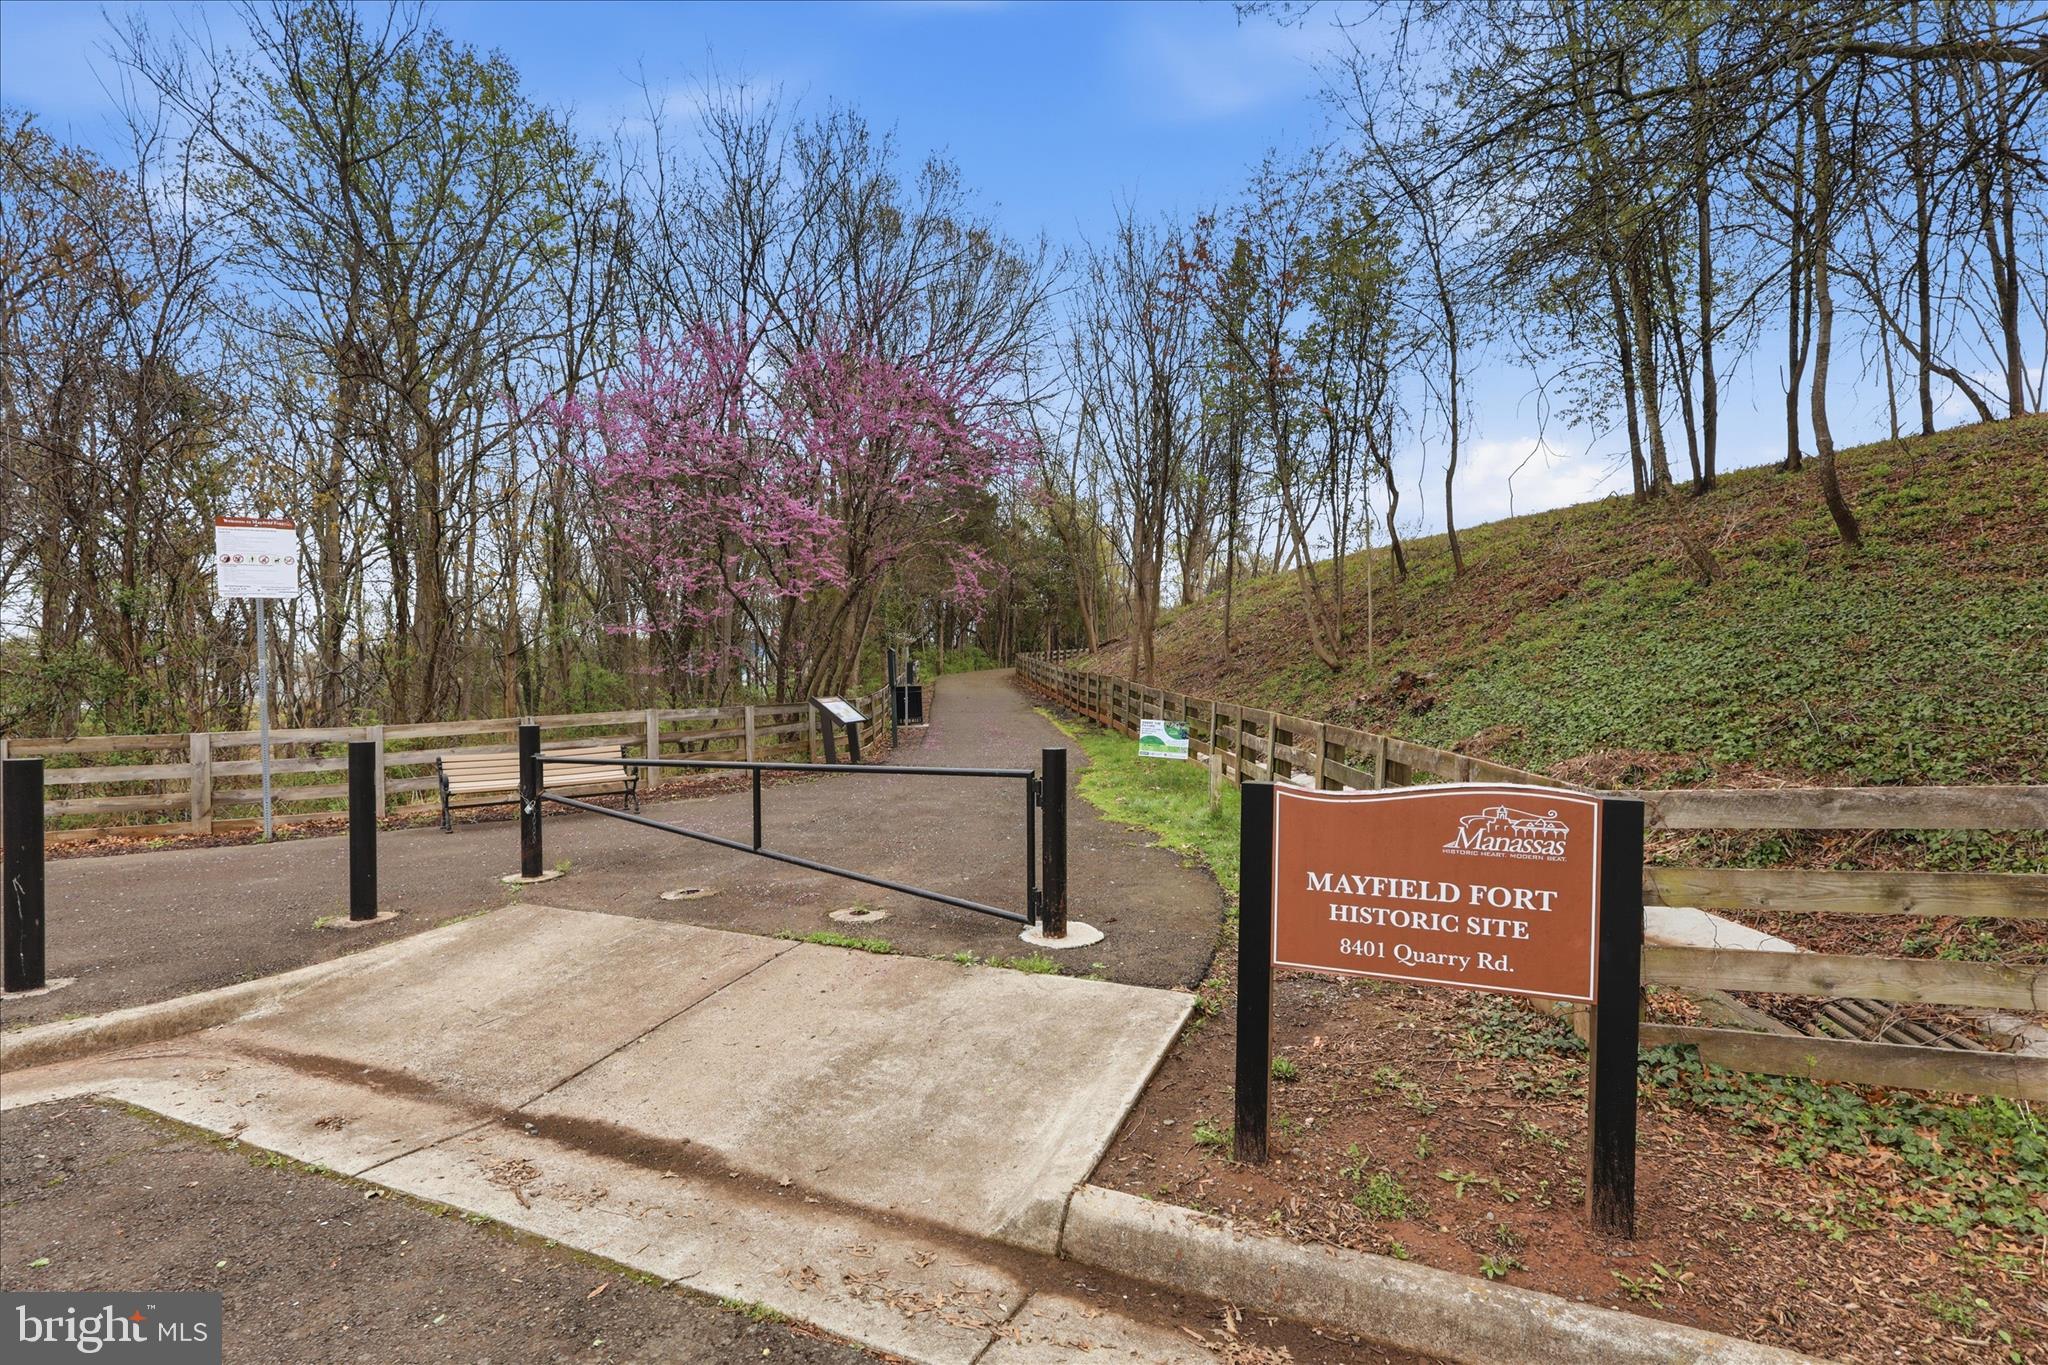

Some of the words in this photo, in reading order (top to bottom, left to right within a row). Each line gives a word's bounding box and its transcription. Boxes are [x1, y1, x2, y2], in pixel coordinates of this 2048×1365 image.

[1442, 848, 1479, 857] HISTORIC
[1454, 826, 1566, 856] Manassas
[1306, 871, 1461, 904] MAYFIELD
[1468, 885, 1558, 912] FORT
[1328, 903, 1459, 933] HISTORIC
[1466, 916, 1530, 940] SITE
[1339, 937, 1385, 959] 8401
[1393, 943, 1471, 972] Quarry
[1476, 952, 1514, 973] Rd.
